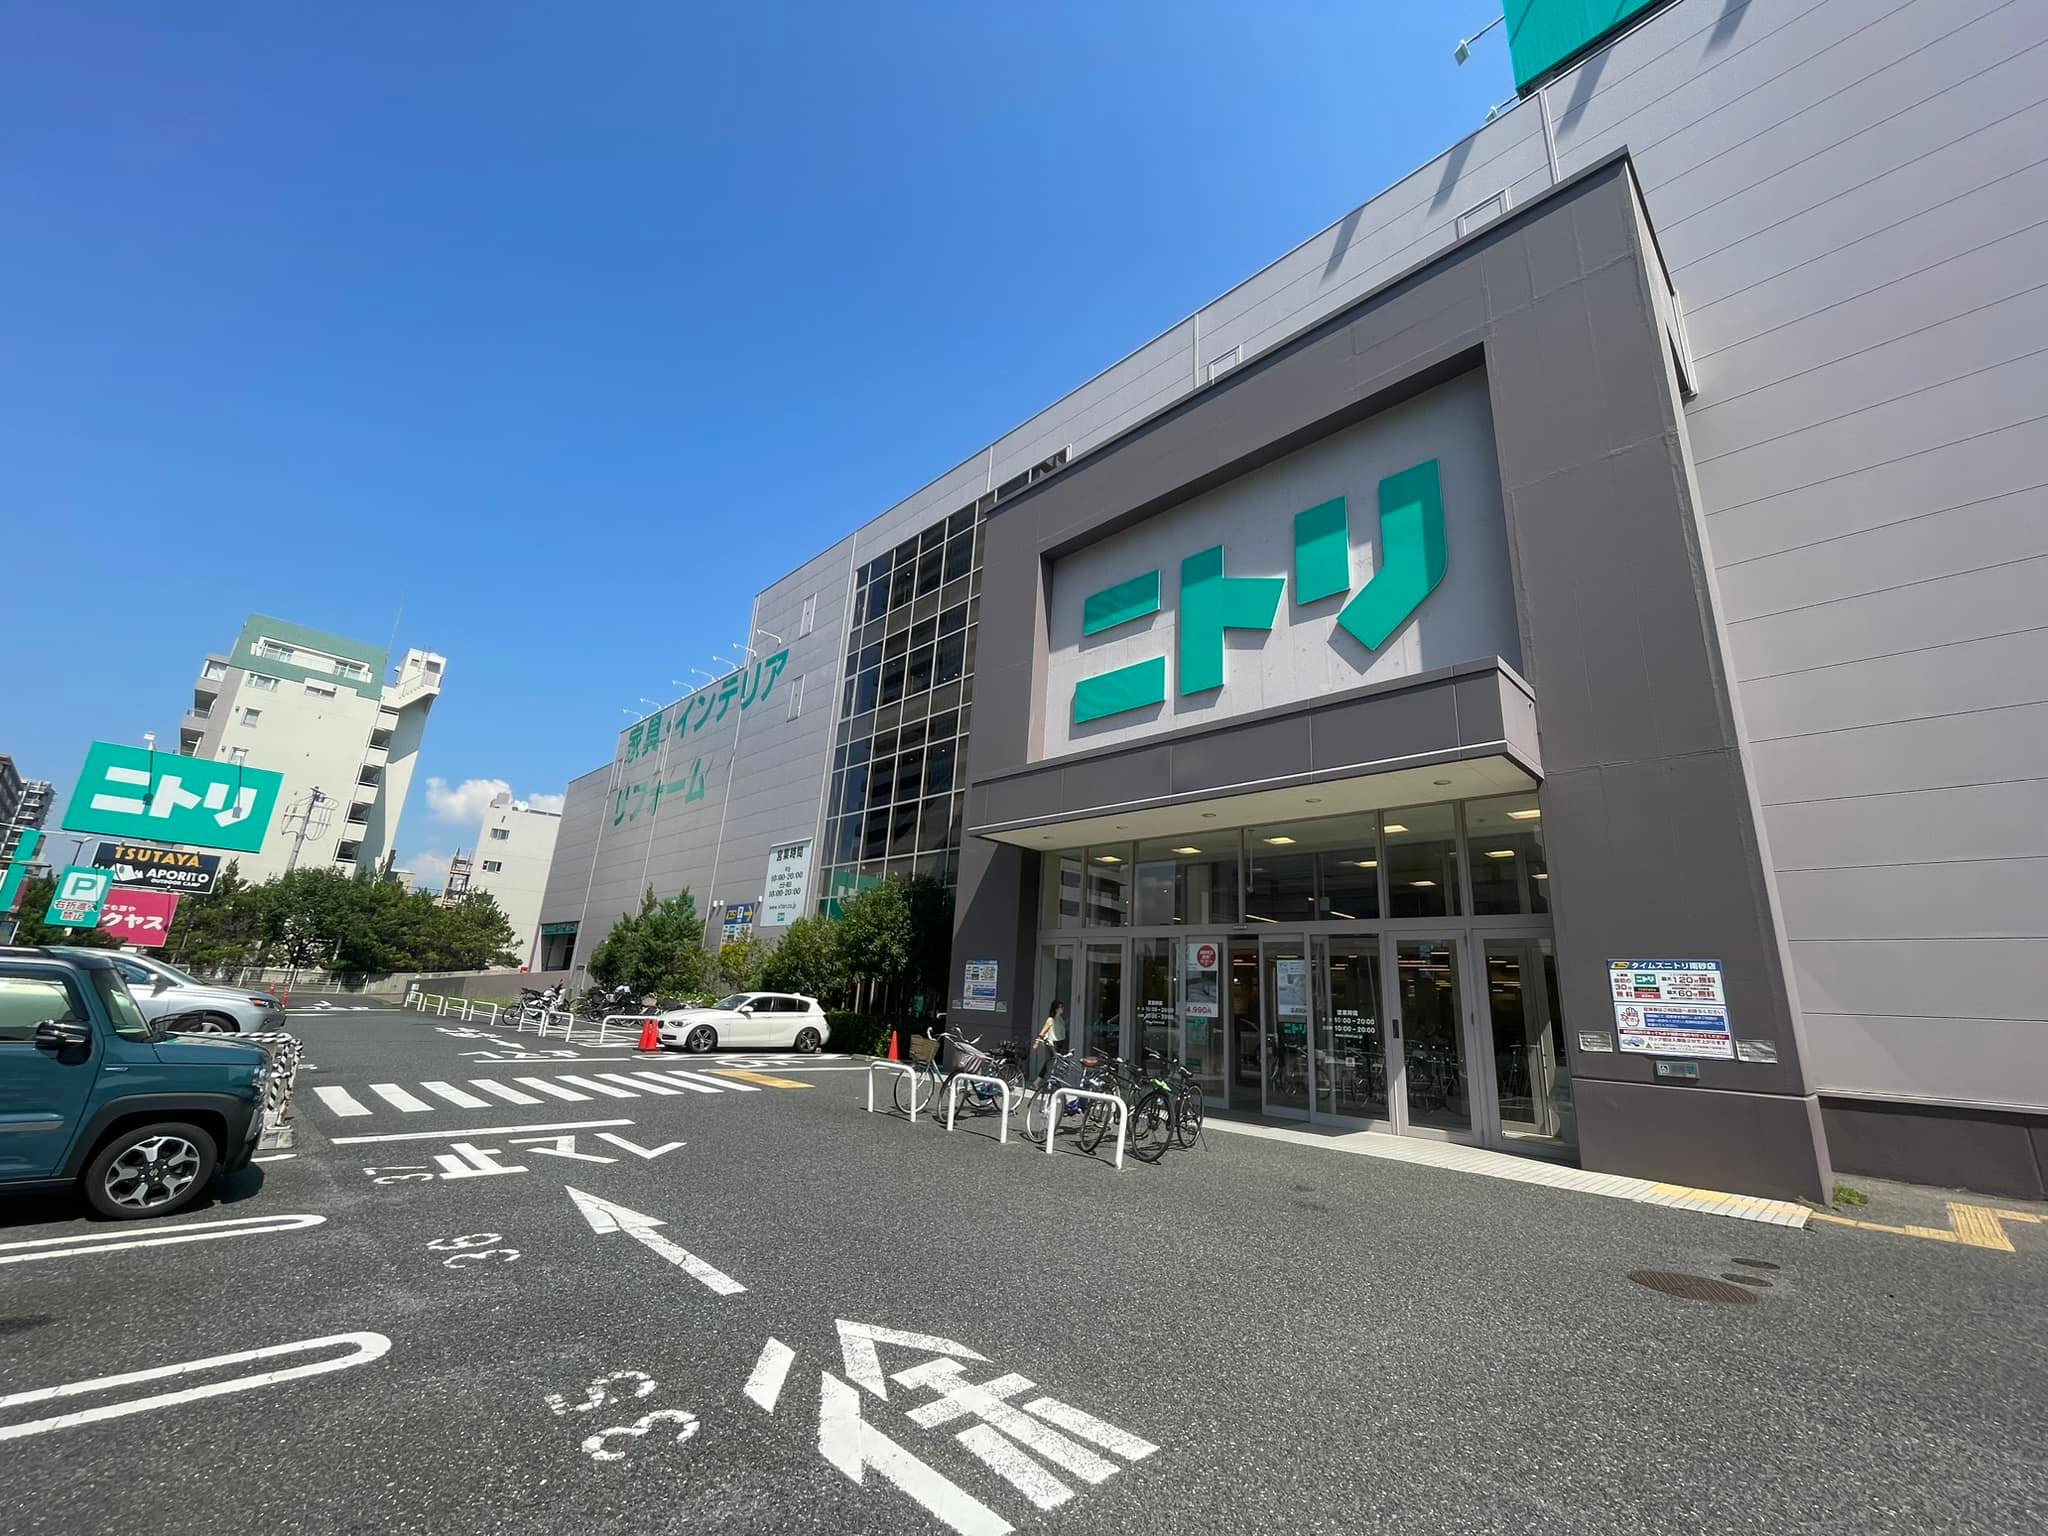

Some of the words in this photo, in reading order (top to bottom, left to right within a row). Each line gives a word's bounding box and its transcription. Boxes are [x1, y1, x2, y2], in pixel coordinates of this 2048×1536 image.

[1074, 458, 1448, 723] ニトリ
[624, 648, 790, 764] 家具・インテリア
[90, 766, 258, 828] ニトリ
[614, 758, 705, 827] リフォーム
[115, 846, 202, 868] TSUTAYA
[145, 868, 209, 884] APORITO
[70, 877, 97, 896] P
[434, 1133, 687, 1179] 止マレ
